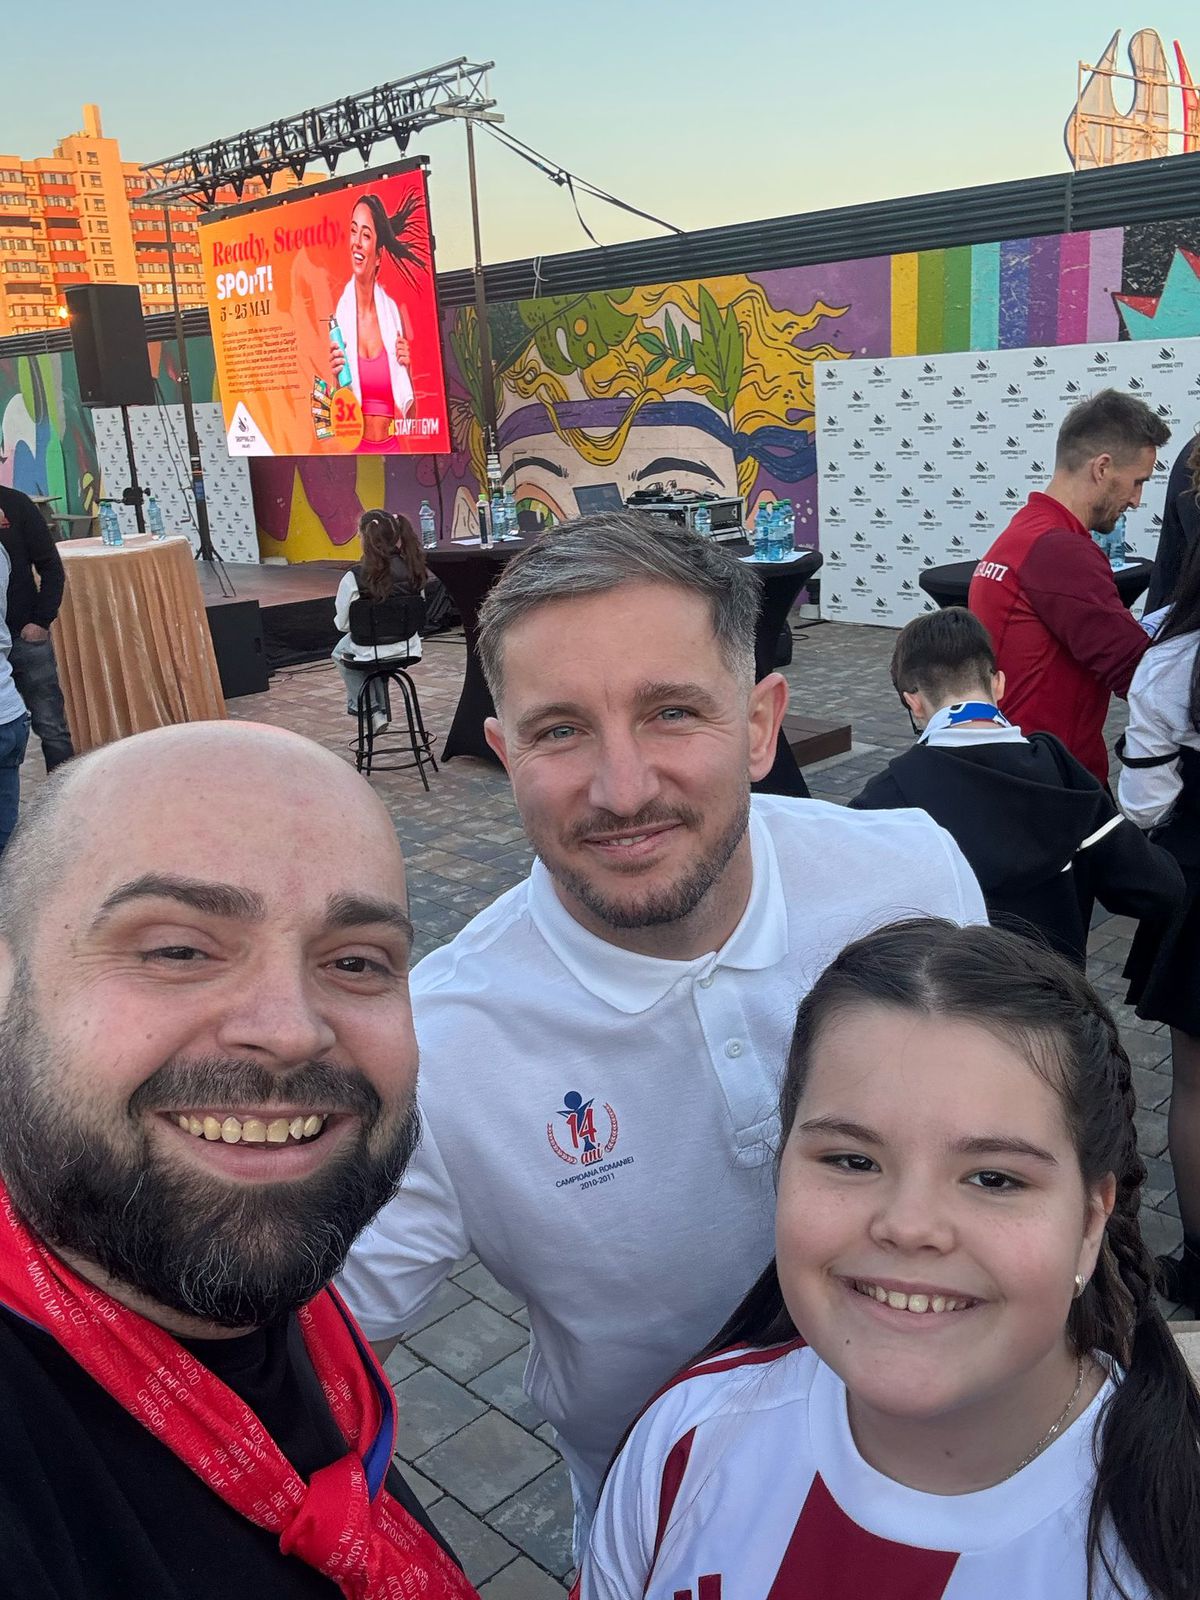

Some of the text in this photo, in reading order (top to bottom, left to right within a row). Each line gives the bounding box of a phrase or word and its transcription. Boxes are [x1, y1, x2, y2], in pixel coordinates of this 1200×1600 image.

[213, 232, 269, 266] Ready,
[249, 299, 270, 318] MAI
[334, 397, 356, 422] 3x
[566, 1108, 597, 1149] 14
[555, 1155, 635, 1188] CAMPIOANA ROMANIEI
[580, 1172, 615, 1190] 2010-2011
